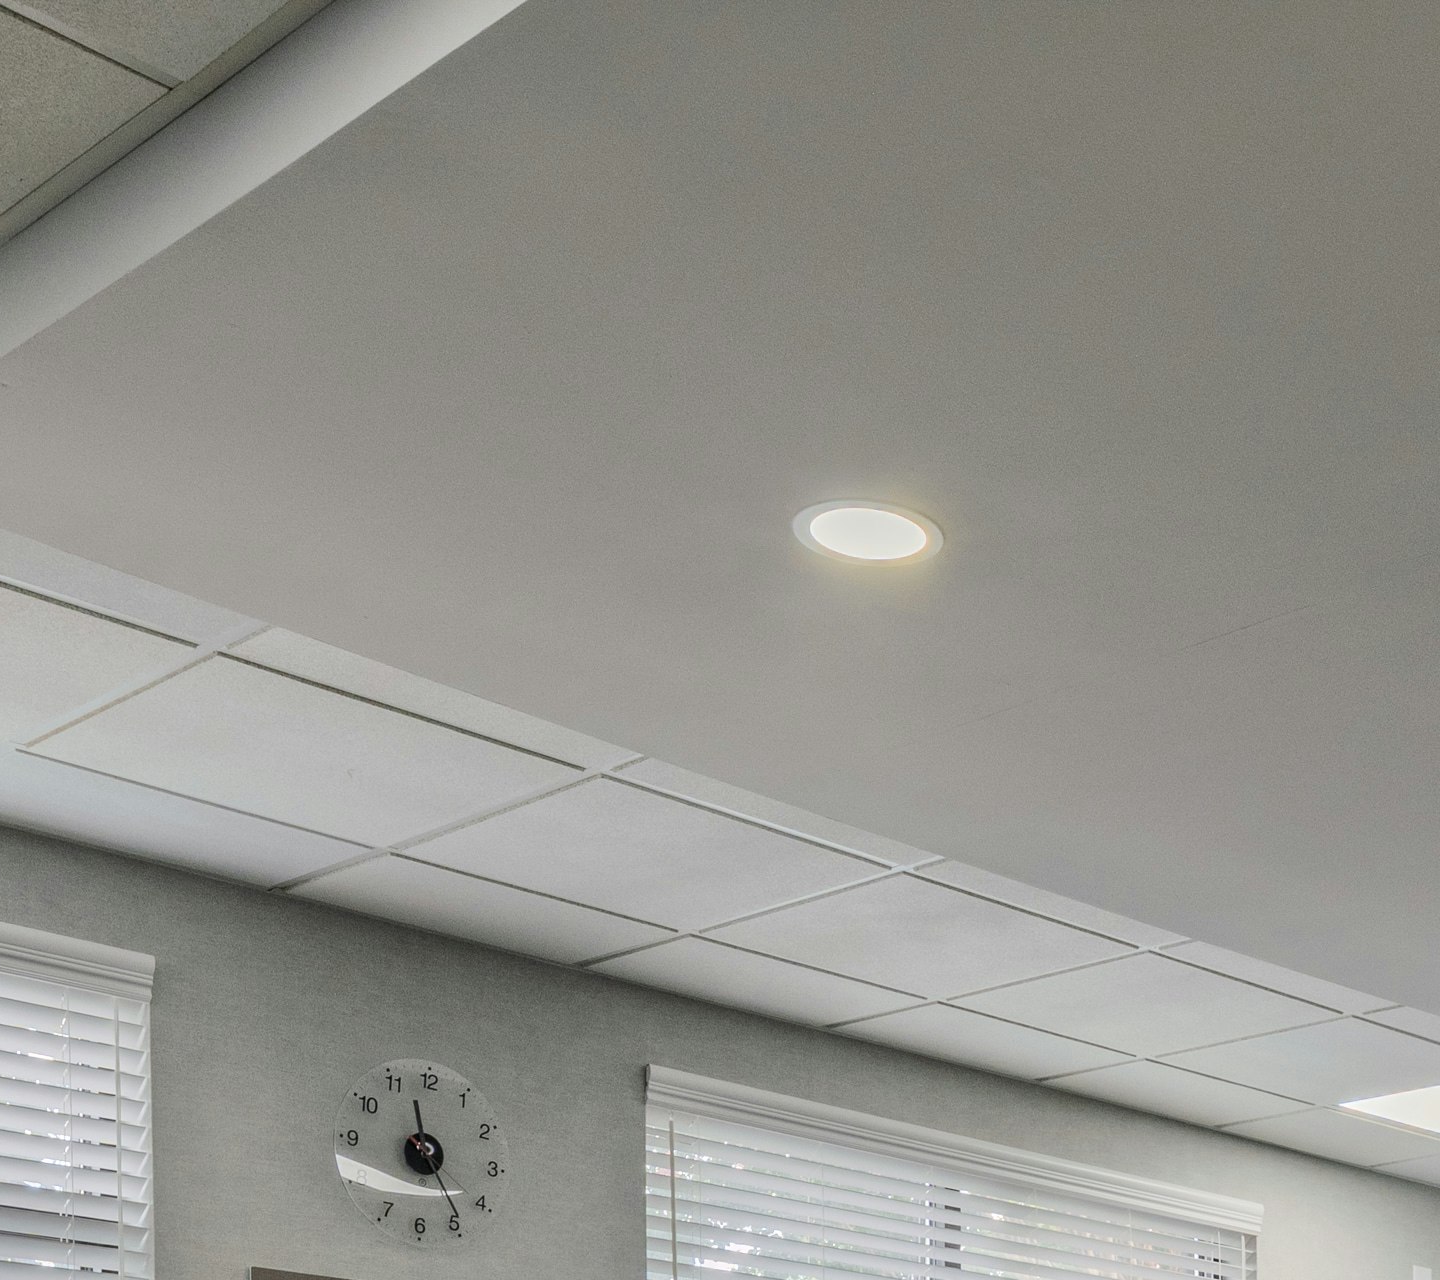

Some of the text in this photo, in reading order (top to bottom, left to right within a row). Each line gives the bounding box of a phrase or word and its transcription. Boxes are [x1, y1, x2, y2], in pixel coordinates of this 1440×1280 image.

[386, 1074, 402, 1093] 11
[420, 1072, 439, 1091] 12
[358, 1095, 379, 1114] 10
[458, 1092, 466, 1108] 1
[346, 1129, 359, 1147] 9
[478, 1123, 490, 1141] 2
[487, 1161, 499, 1178] 3
[382, 1201, 395, 1218] 7
[474, 1194, 487, 1211] 4
[414, 1217, 426, 1234] 6
[448, 1214, 461, 1232] 5
